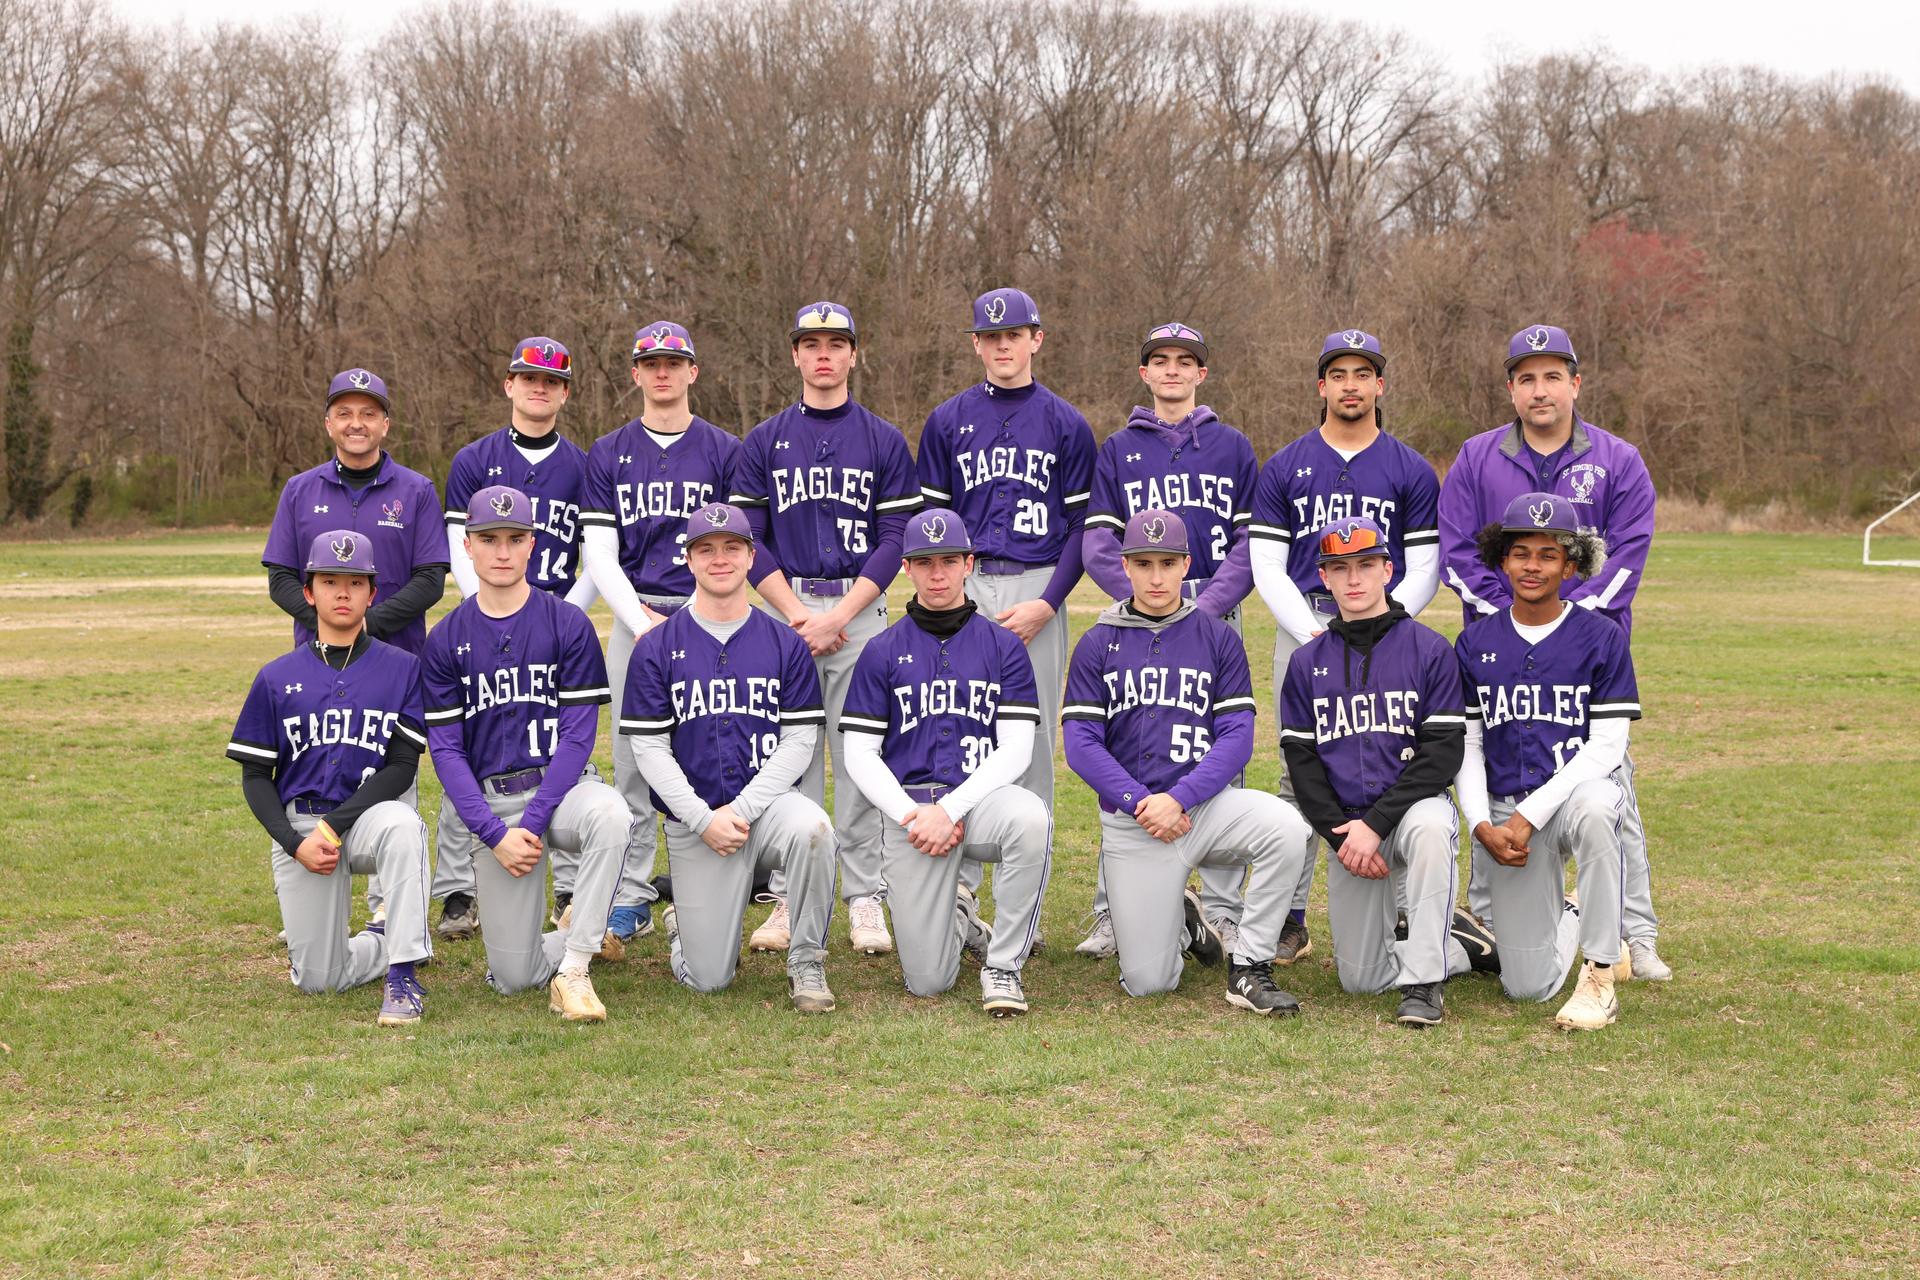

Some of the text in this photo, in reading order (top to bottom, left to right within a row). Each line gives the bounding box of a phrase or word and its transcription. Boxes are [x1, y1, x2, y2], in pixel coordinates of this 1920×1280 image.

[772, 466, 874, 514] EAGLES
[957, 447, 1056, 494] EAGLES
[530, 496, 580, 544] LES
[615, 481, 714, 527] EAGLES
[1013, 498, 1049, 536] 20
[1124, 473, 1234, 520] EAGLES
[377, 520, 404, 529] BASEBALL
[837, 518, 868, 553] 75
[1210, 525, 1228, 561] 2
[537, 548, 568, 581] 14
[461, 664, 558, 719] EAGLES
[670, 677, 780, 726] EAGLES
[894, 679, 1001, 735] EAGLES
[1103, 667, 1212, 720] EAGLES
[1477, 684, 1591, 731] EAGLES
[283, 709, 399, 762] EAGLES
[527, 718, 559, 757] 17
[1312, 690, 1419, 745] EAGLES
[749, 733, 778, 770] 19
[960, 735, 993, 774] 30
[1169, 723, 1212, 763] 55
